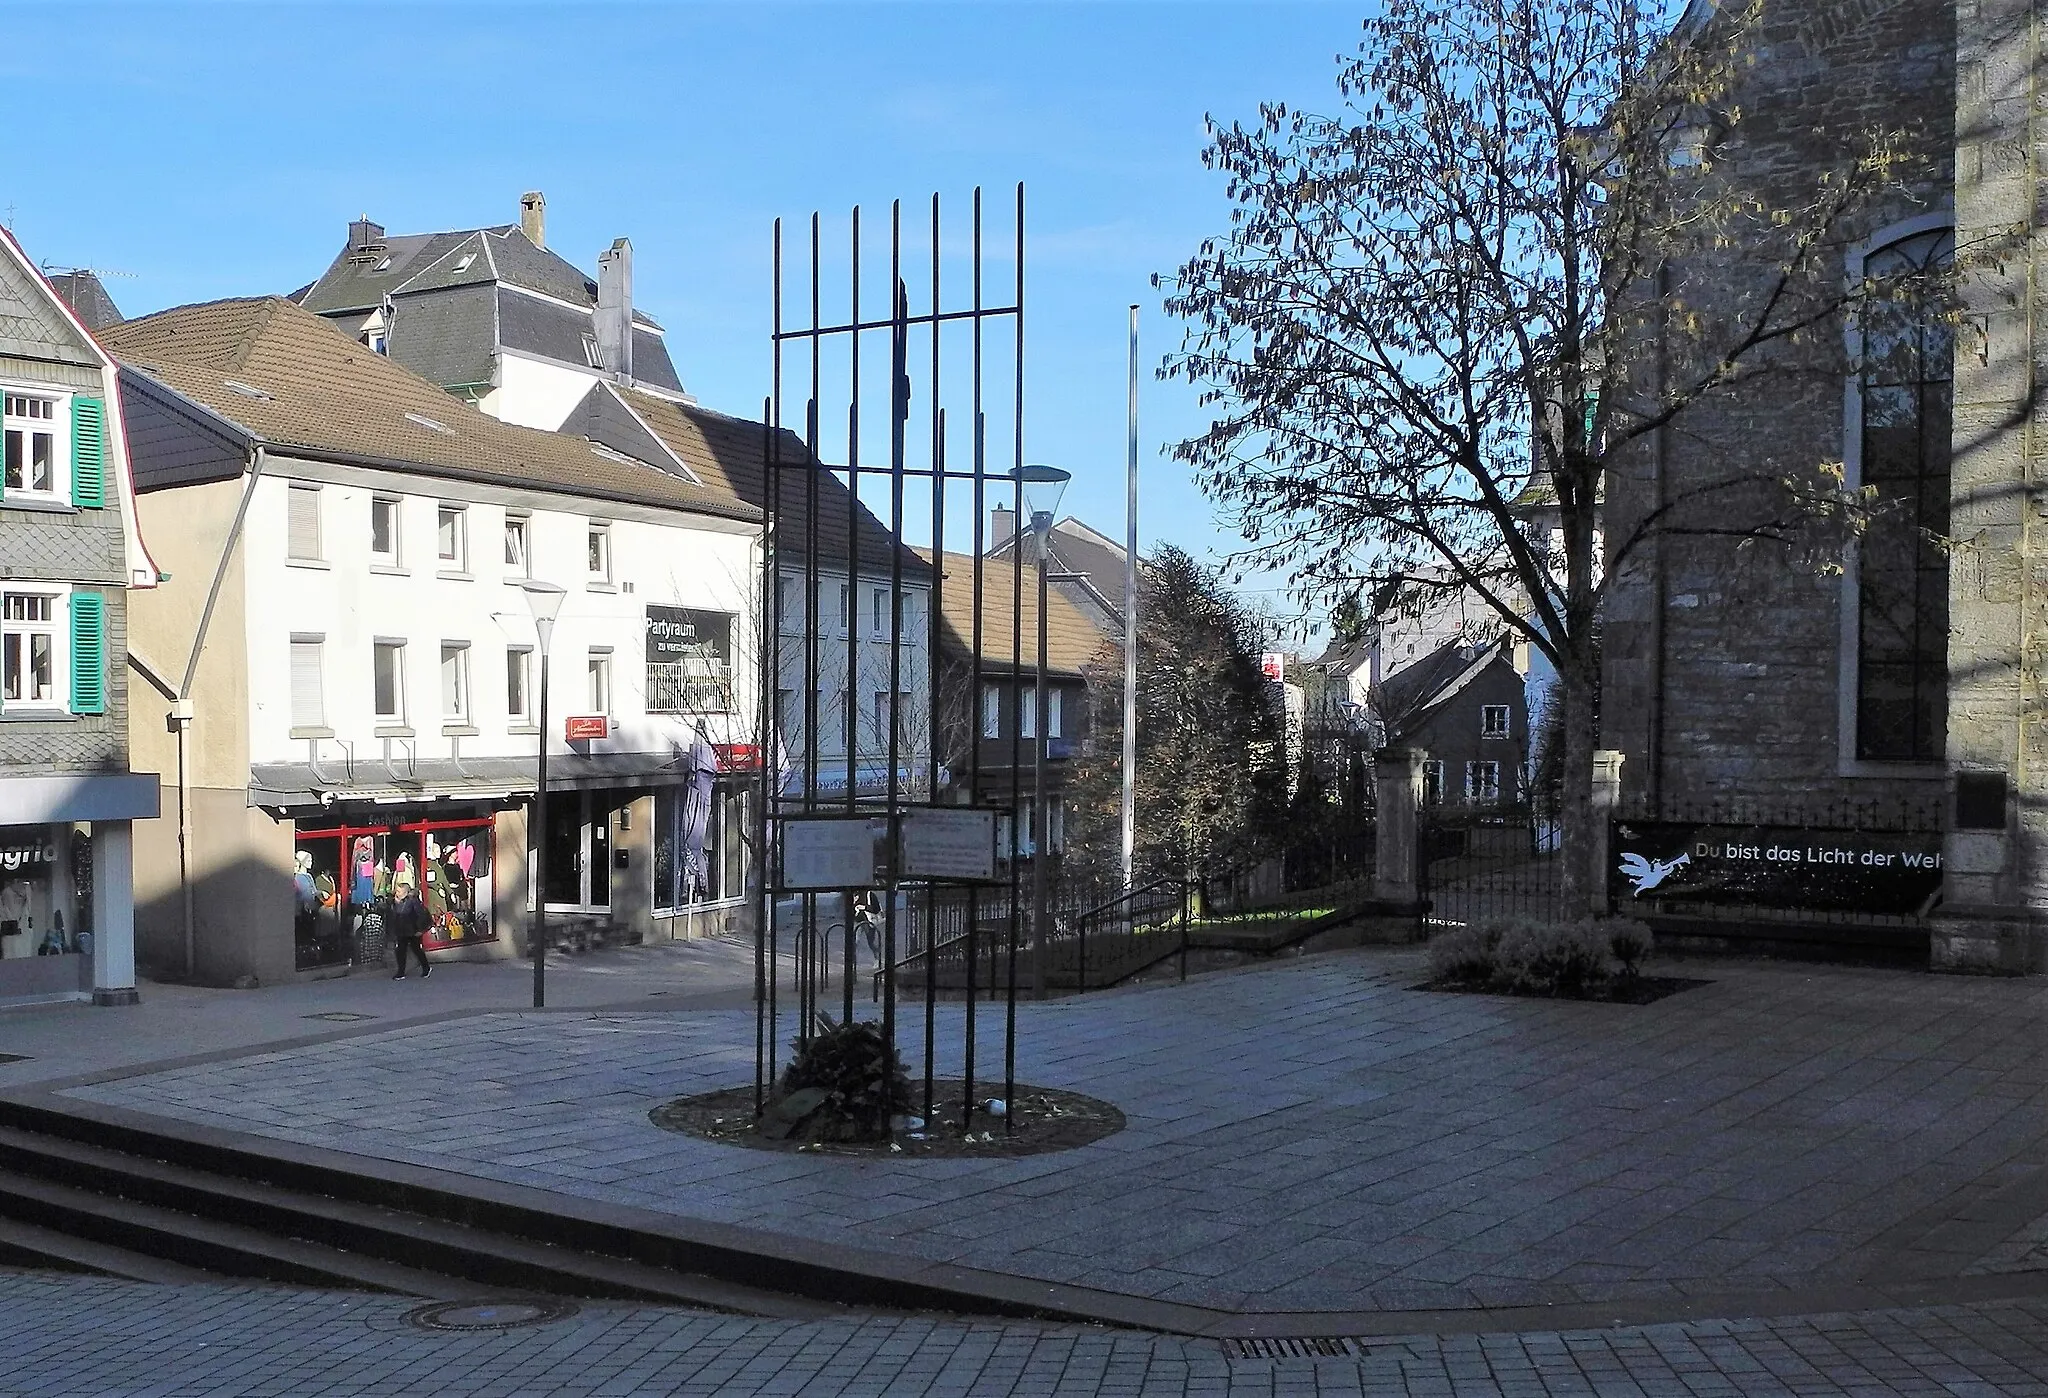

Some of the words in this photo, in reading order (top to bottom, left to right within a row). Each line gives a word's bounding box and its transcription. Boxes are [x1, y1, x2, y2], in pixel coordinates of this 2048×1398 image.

[646, 617, 695, 639] Partyraum
[657, 642, 666, 651] zu
[1695, 842, 1720, 858] Du
[1726, 843, 1760, 860] bist
[1766, 845, 1801, 861] das
[1807, 847, 1855, 864] Licht
[1860, 849, 1896, 866] der
[1901, 851, 1944, 869] Wel
